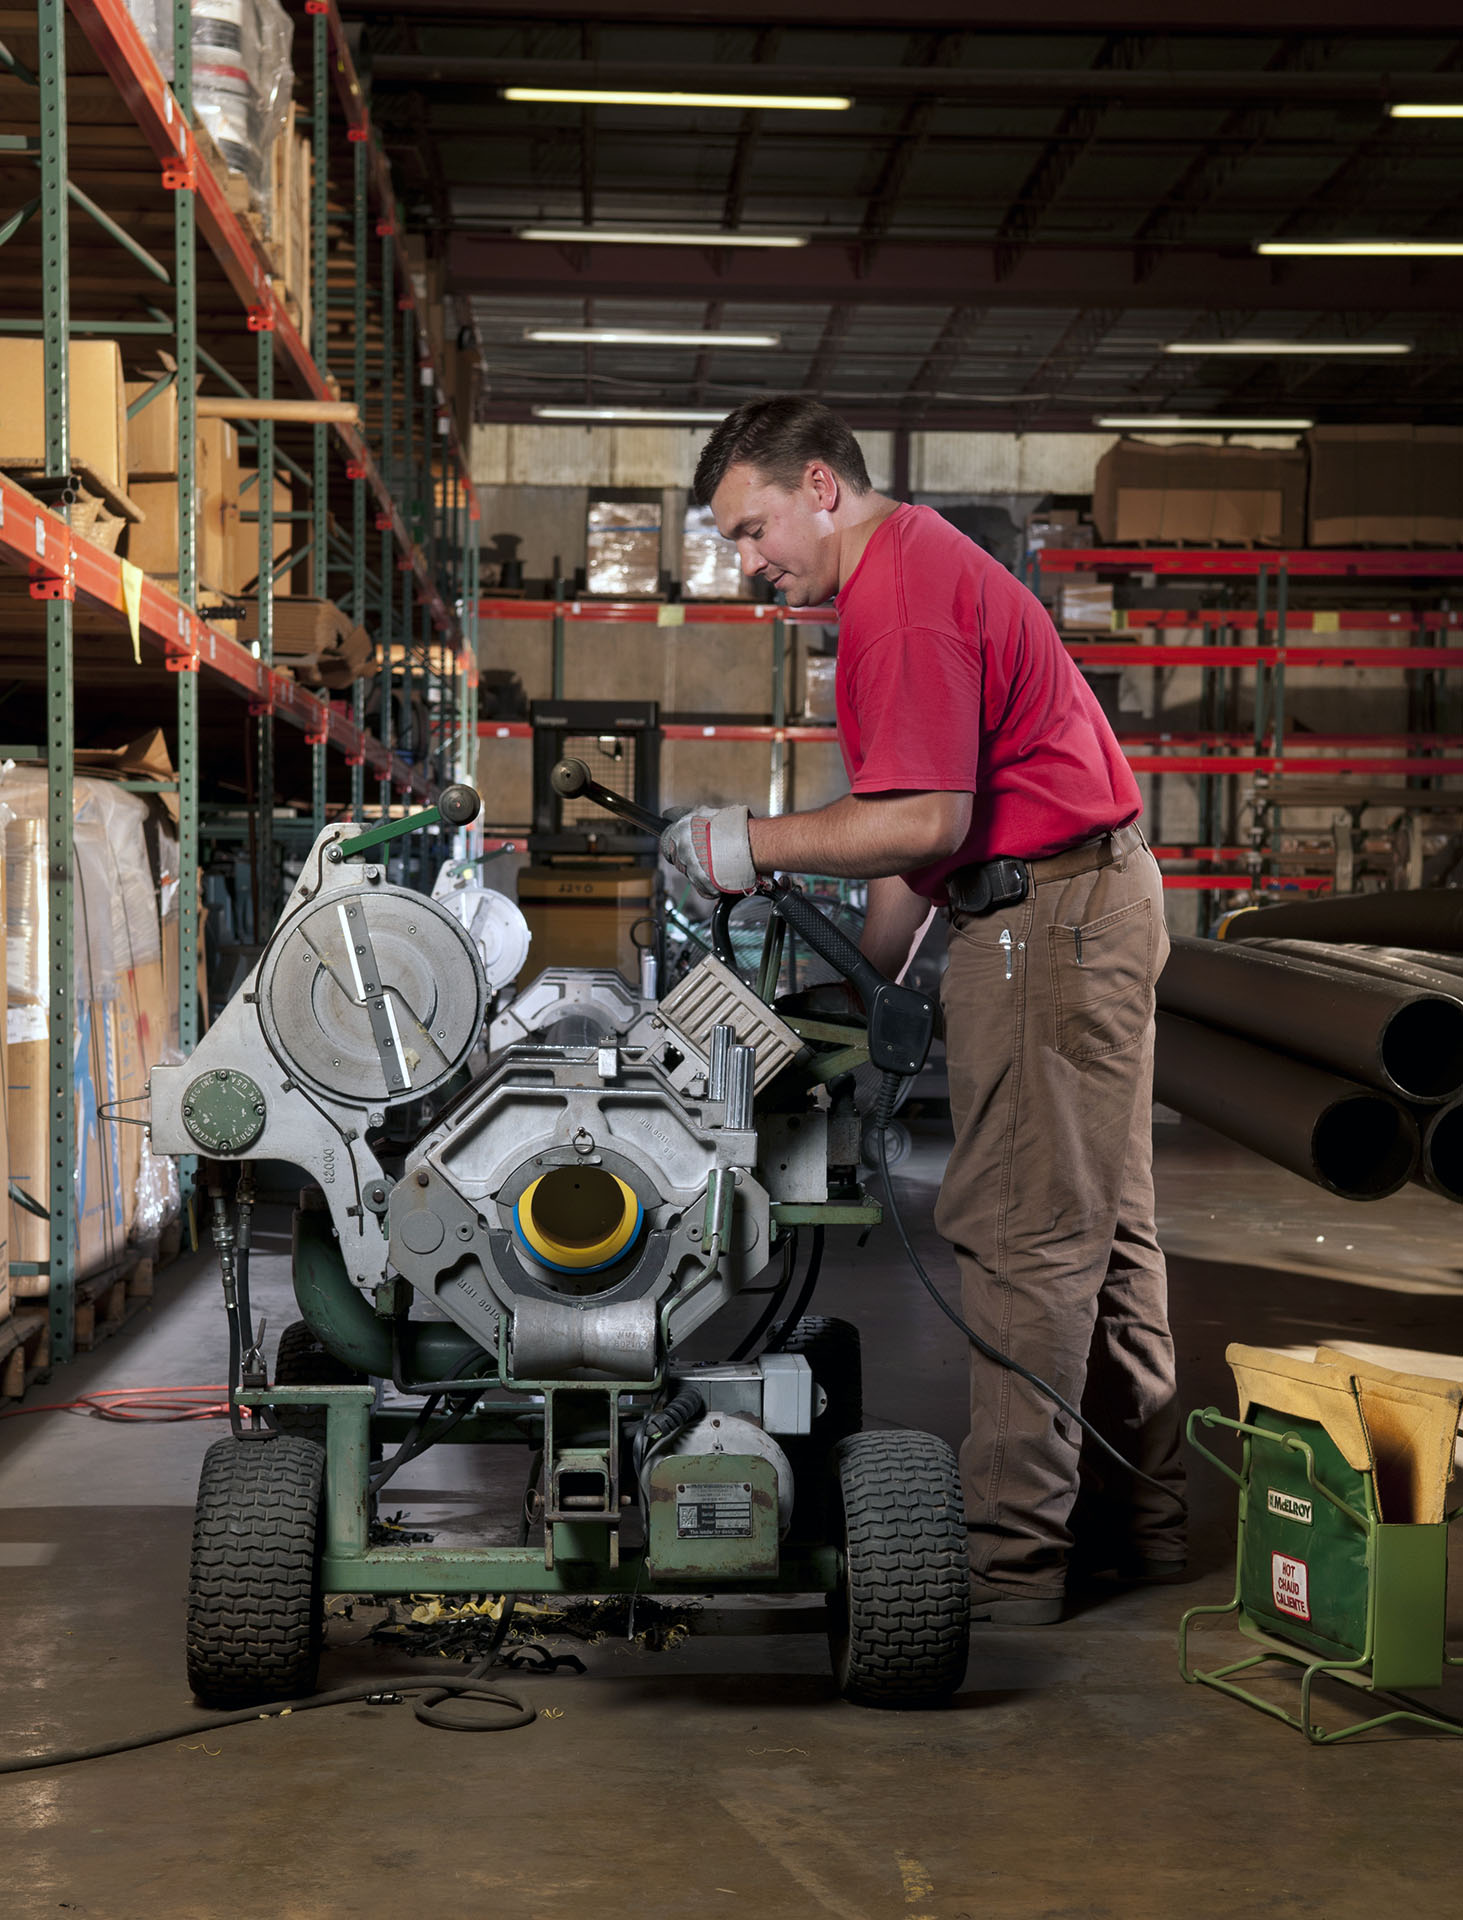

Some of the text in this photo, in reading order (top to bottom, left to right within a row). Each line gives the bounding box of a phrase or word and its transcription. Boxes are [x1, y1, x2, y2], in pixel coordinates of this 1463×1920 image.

[457, 1279, 478, 1298] MMI
[1282, 1562, 1295, 1578] HOT
[1278, 1577, 1299, 1595] CHAUD
[1276, 1592, 1306, 1613] CALIENTE
